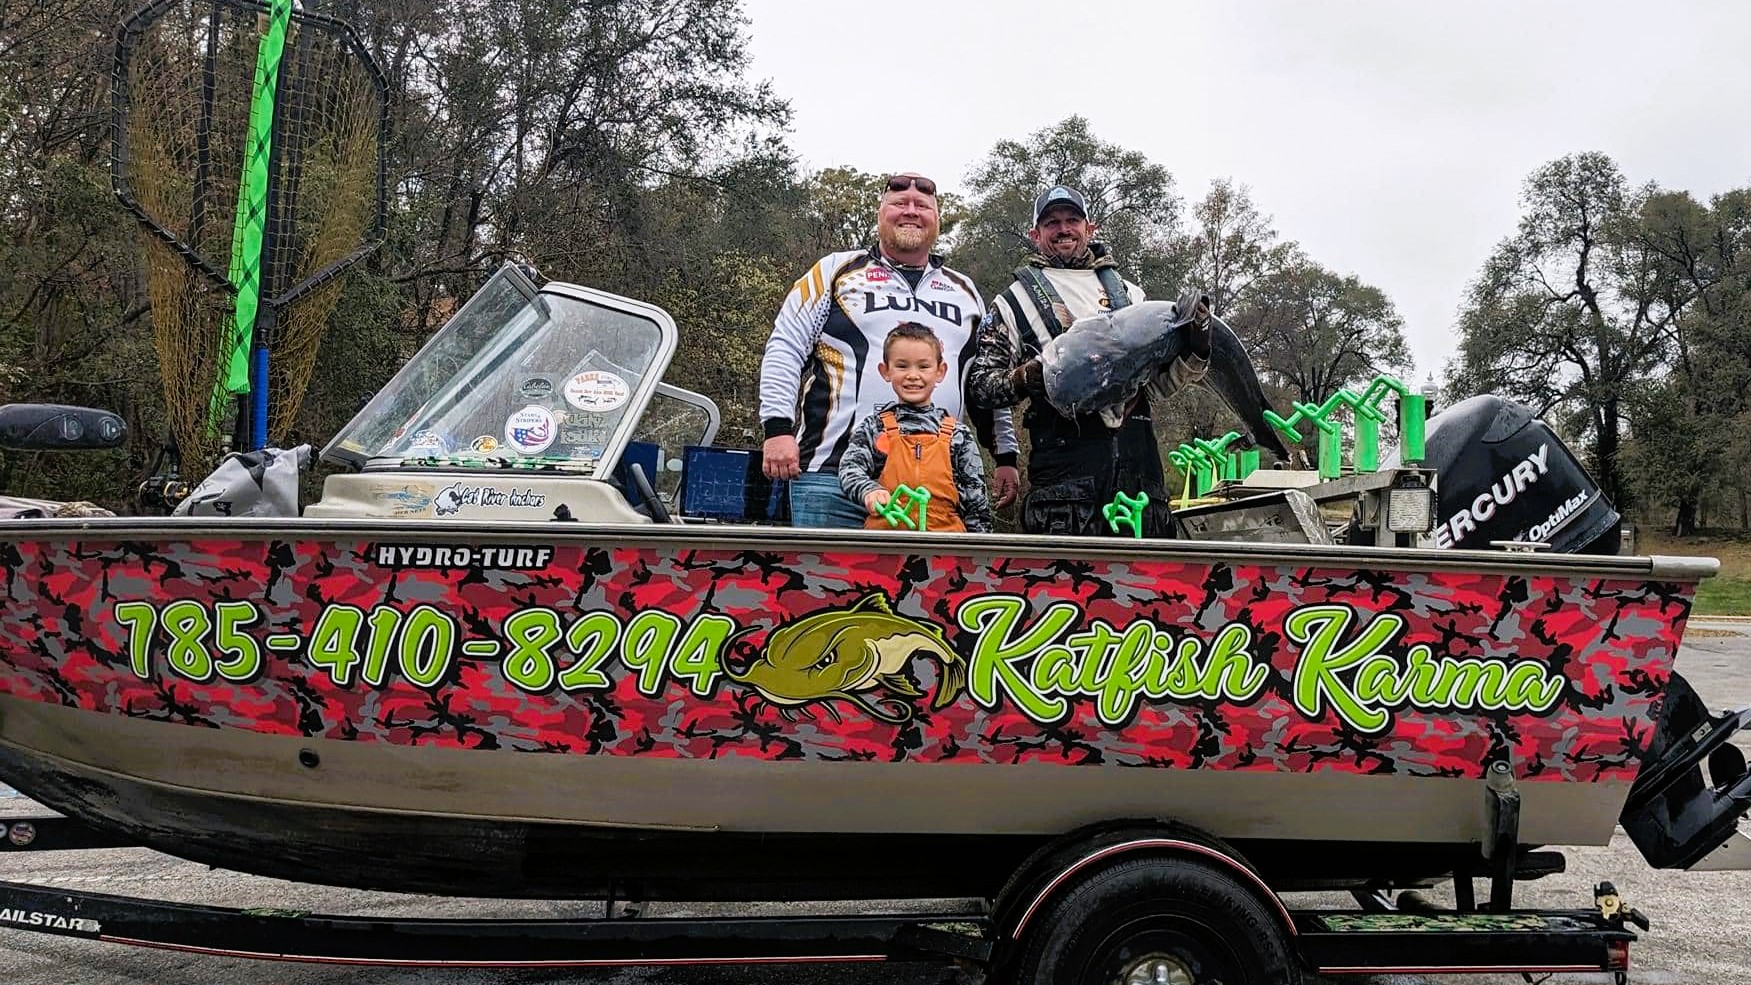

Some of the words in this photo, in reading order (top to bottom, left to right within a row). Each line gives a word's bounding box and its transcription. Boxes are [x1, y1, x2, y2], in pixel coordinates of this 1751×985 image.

[863, 291, 962, 327] LUND
[480, 486, 508, 507] River
[1436, 444, 1549, 549] ERCURY
[1528, 489, 1589, 543] OptiMax
[378, 546, 551, 568] HYDRO-TURF
[115, 600, 736, 697] 785-410-8294
[957, 595, 1269, 725] Katfish
[1286, 605, 1566, 734] Karma
[0, 908, 84, 932] AILSTAR
